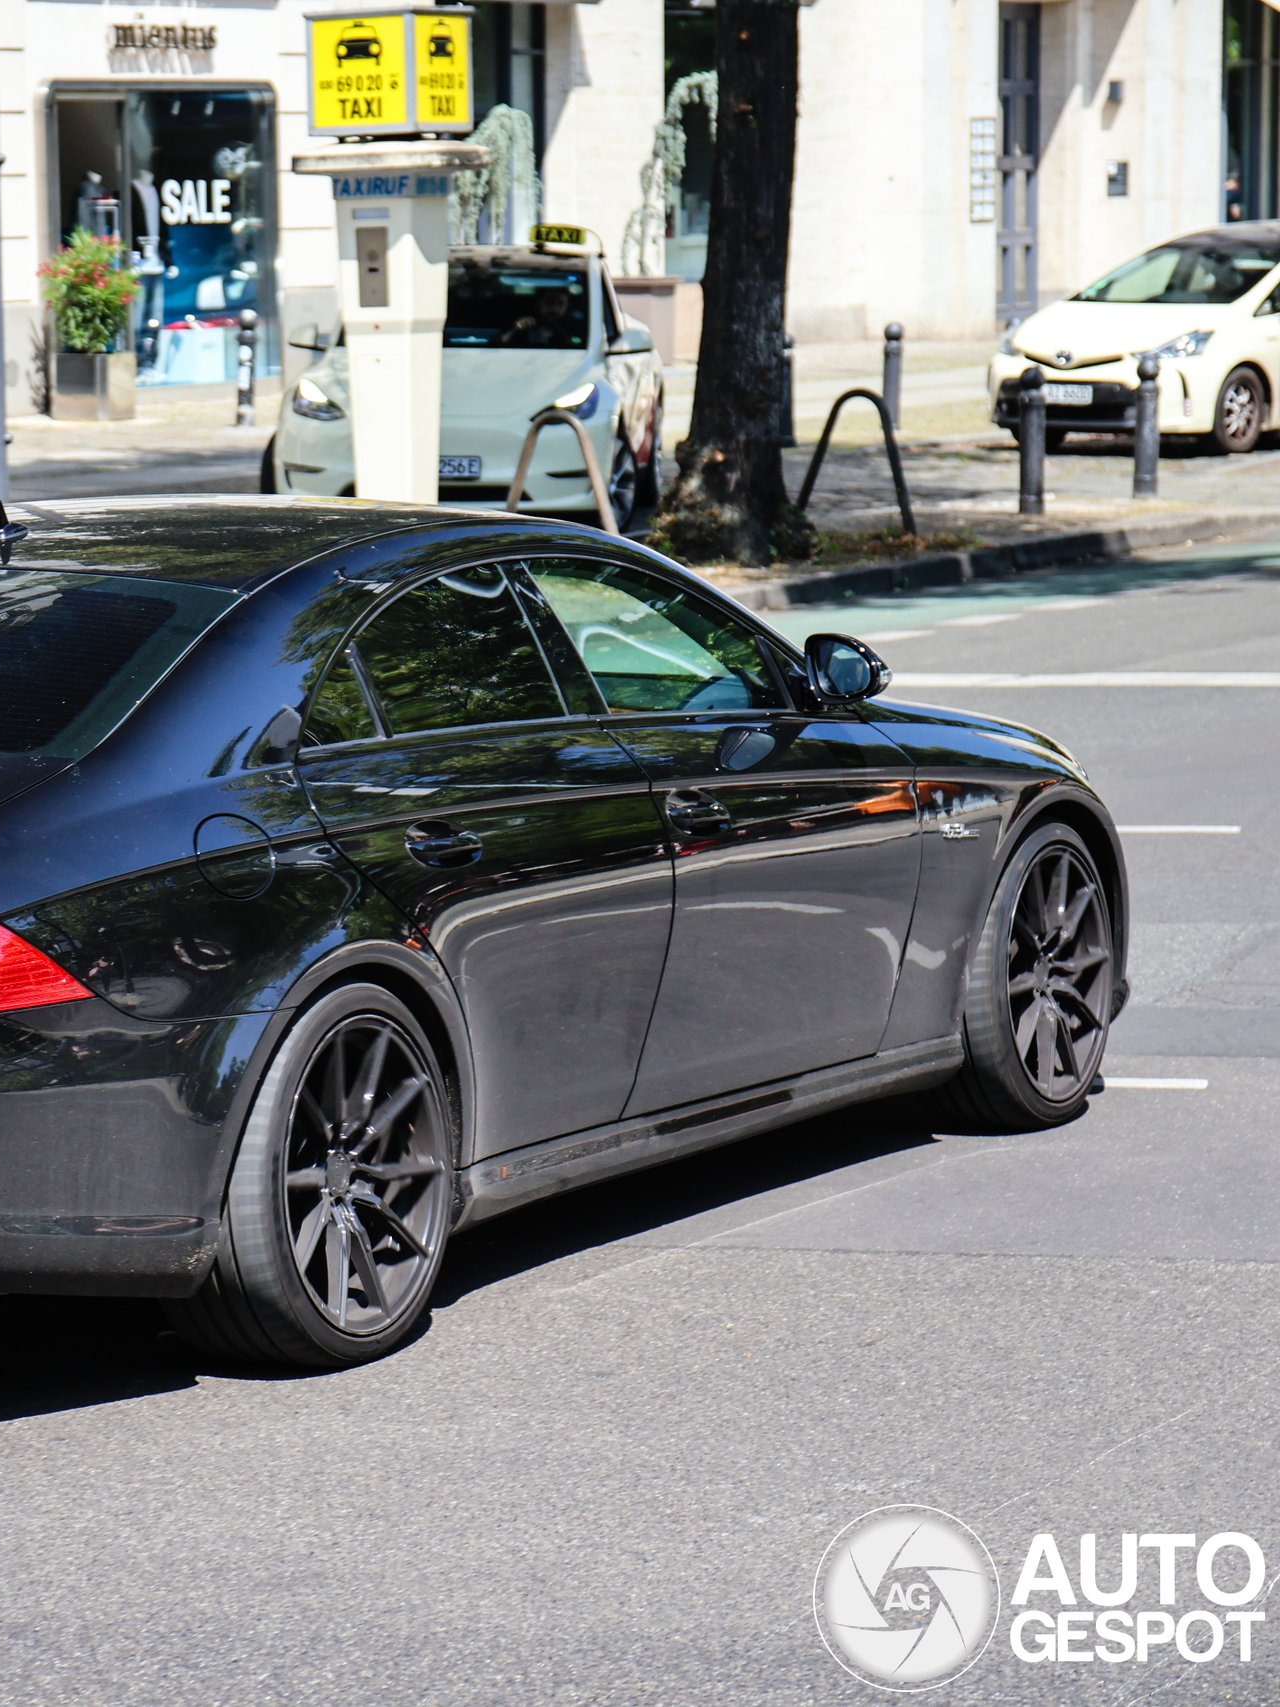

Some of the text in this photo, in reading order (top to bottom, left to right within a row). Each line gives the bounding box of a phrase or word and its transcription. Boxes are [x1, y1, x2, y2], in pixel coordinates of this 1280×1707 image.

[106, 12, 217, 49] mientus
[338, 97, 382, 118] TAXI
[430, 95, 455, 116] TAXI
[161, 179, 232, 225] SALE
[540, 227, 579, 242] TAXI
